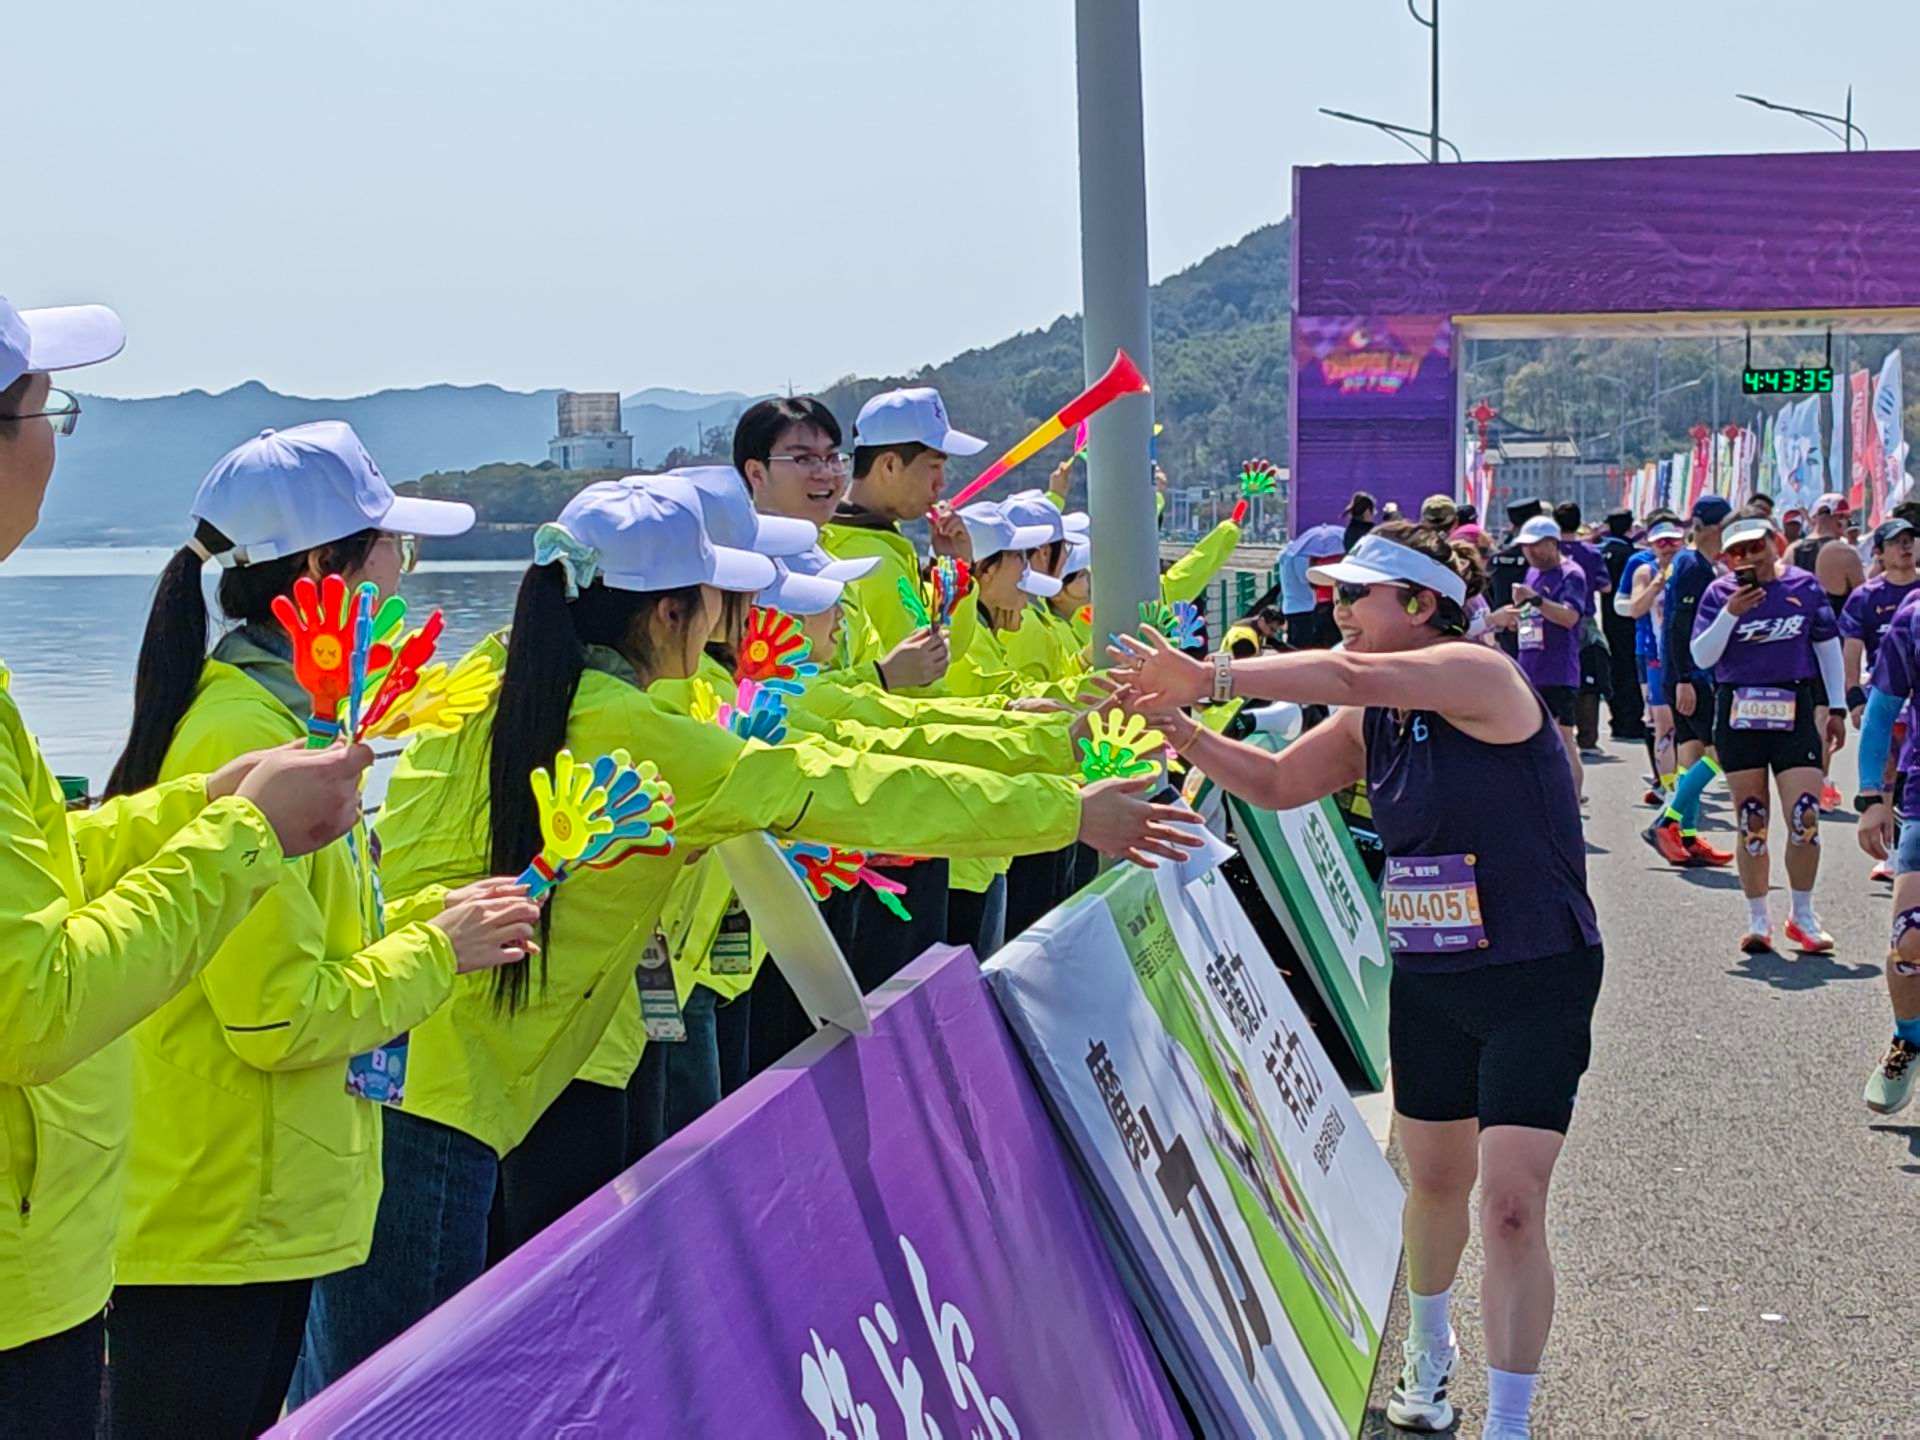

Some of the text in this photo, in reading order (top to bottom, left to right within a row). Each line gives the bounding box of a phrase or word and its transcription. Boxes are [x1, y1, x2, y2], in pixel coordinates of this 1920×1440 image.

[1744, 370, 1831, 392] 4:43:35
[1736, 613, 1805, 642] 宁波
[1388, 892, 1463, 921] 40405
[1262, 1018, 1324, 1134] 有活力
[1083, 1037, 1271, 1385] 魔力
